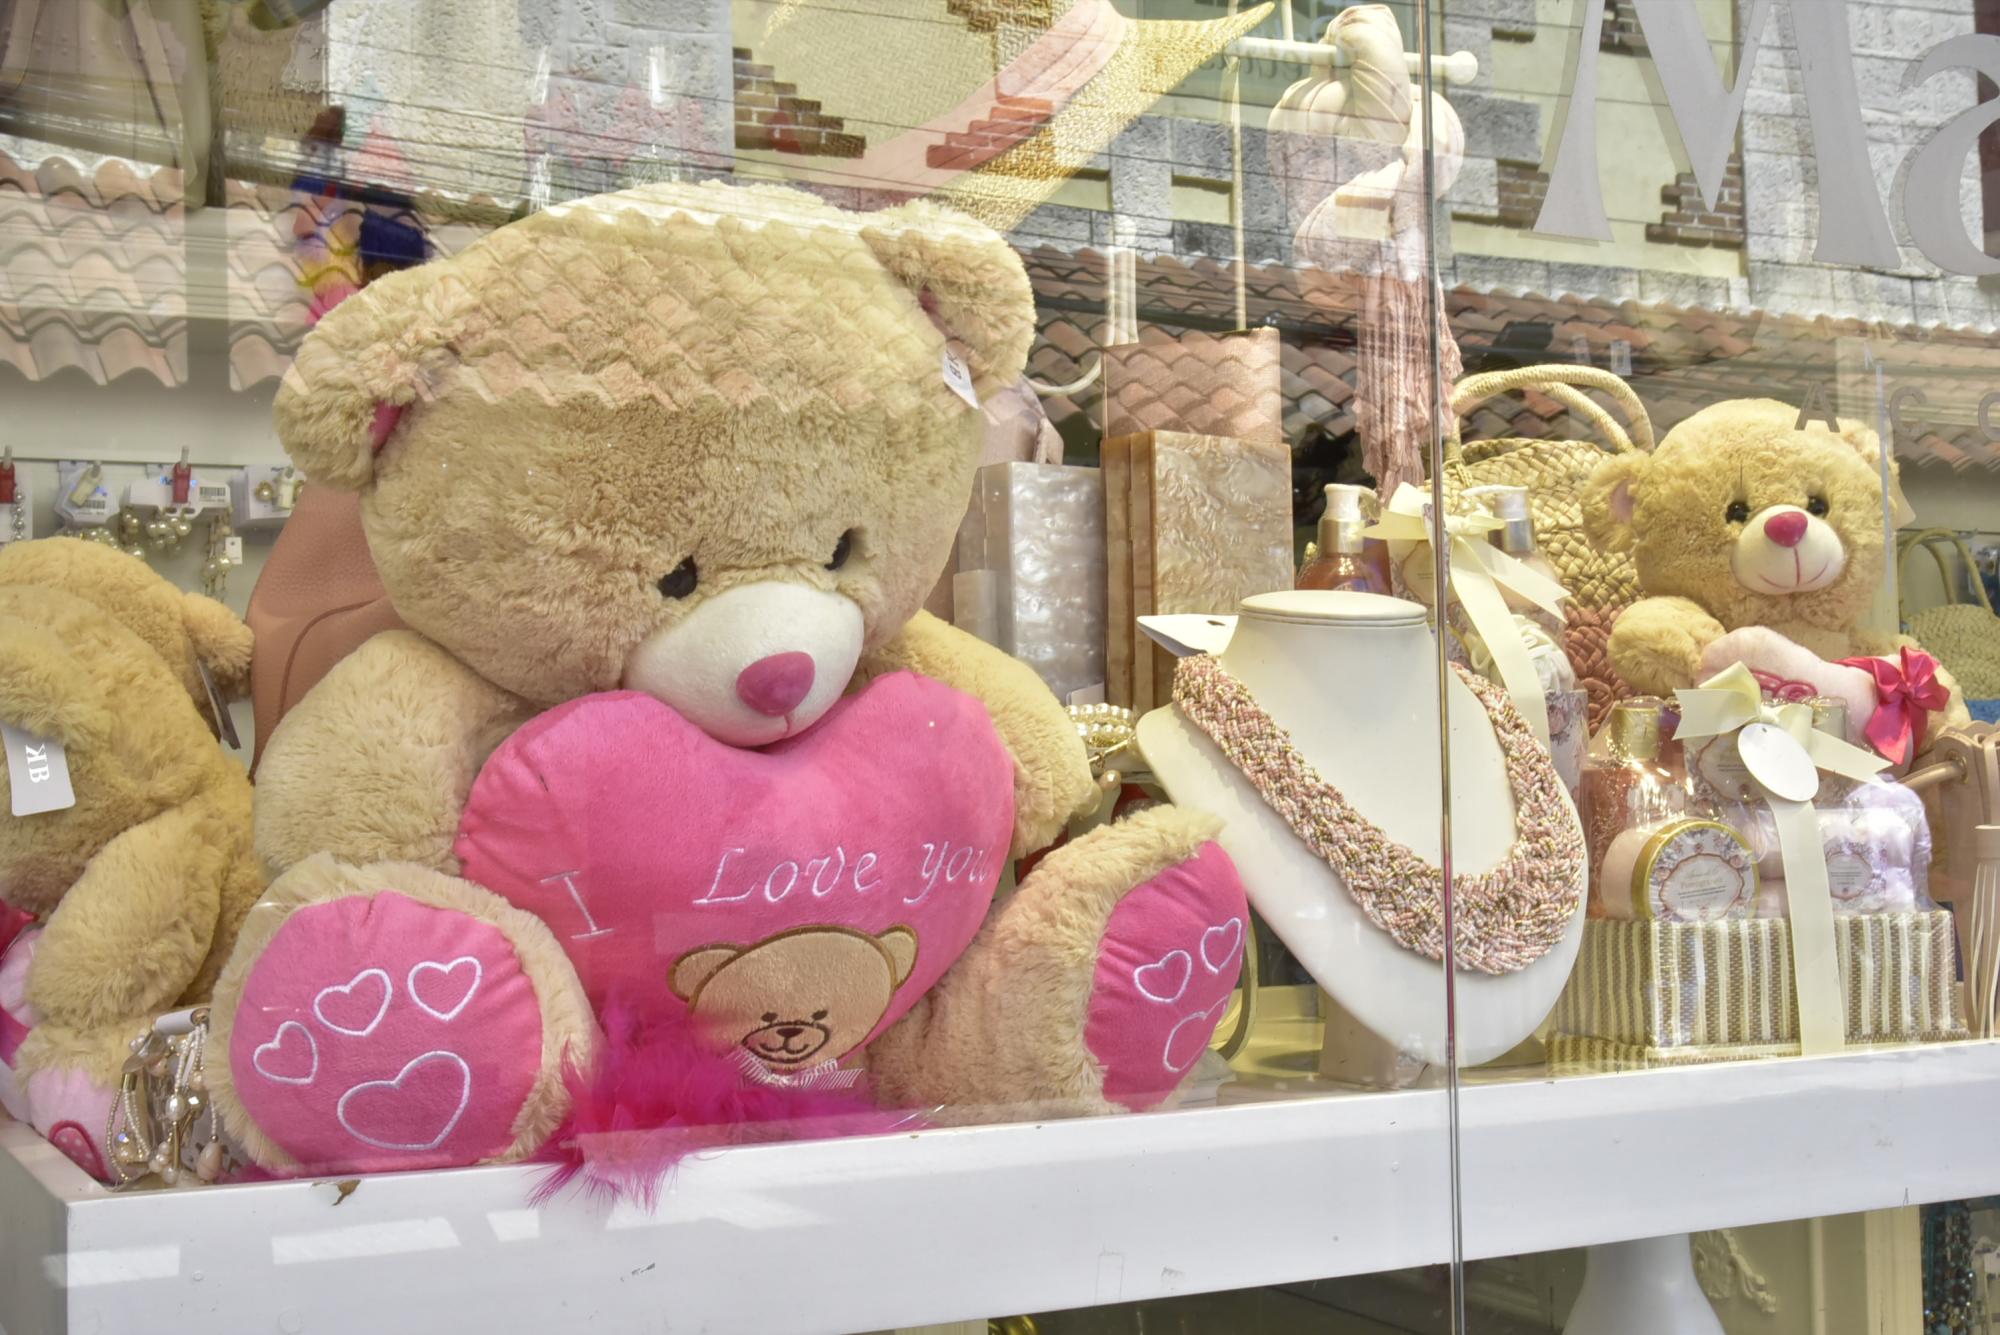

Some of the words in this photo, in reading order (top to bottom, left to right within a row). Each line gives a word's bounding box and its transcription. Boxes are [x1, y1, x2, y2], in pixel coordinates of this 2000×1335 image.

[540, 870, 615, 940] I
[692, 845, 883, 904] Love
[903, 841, 993, 904] you
